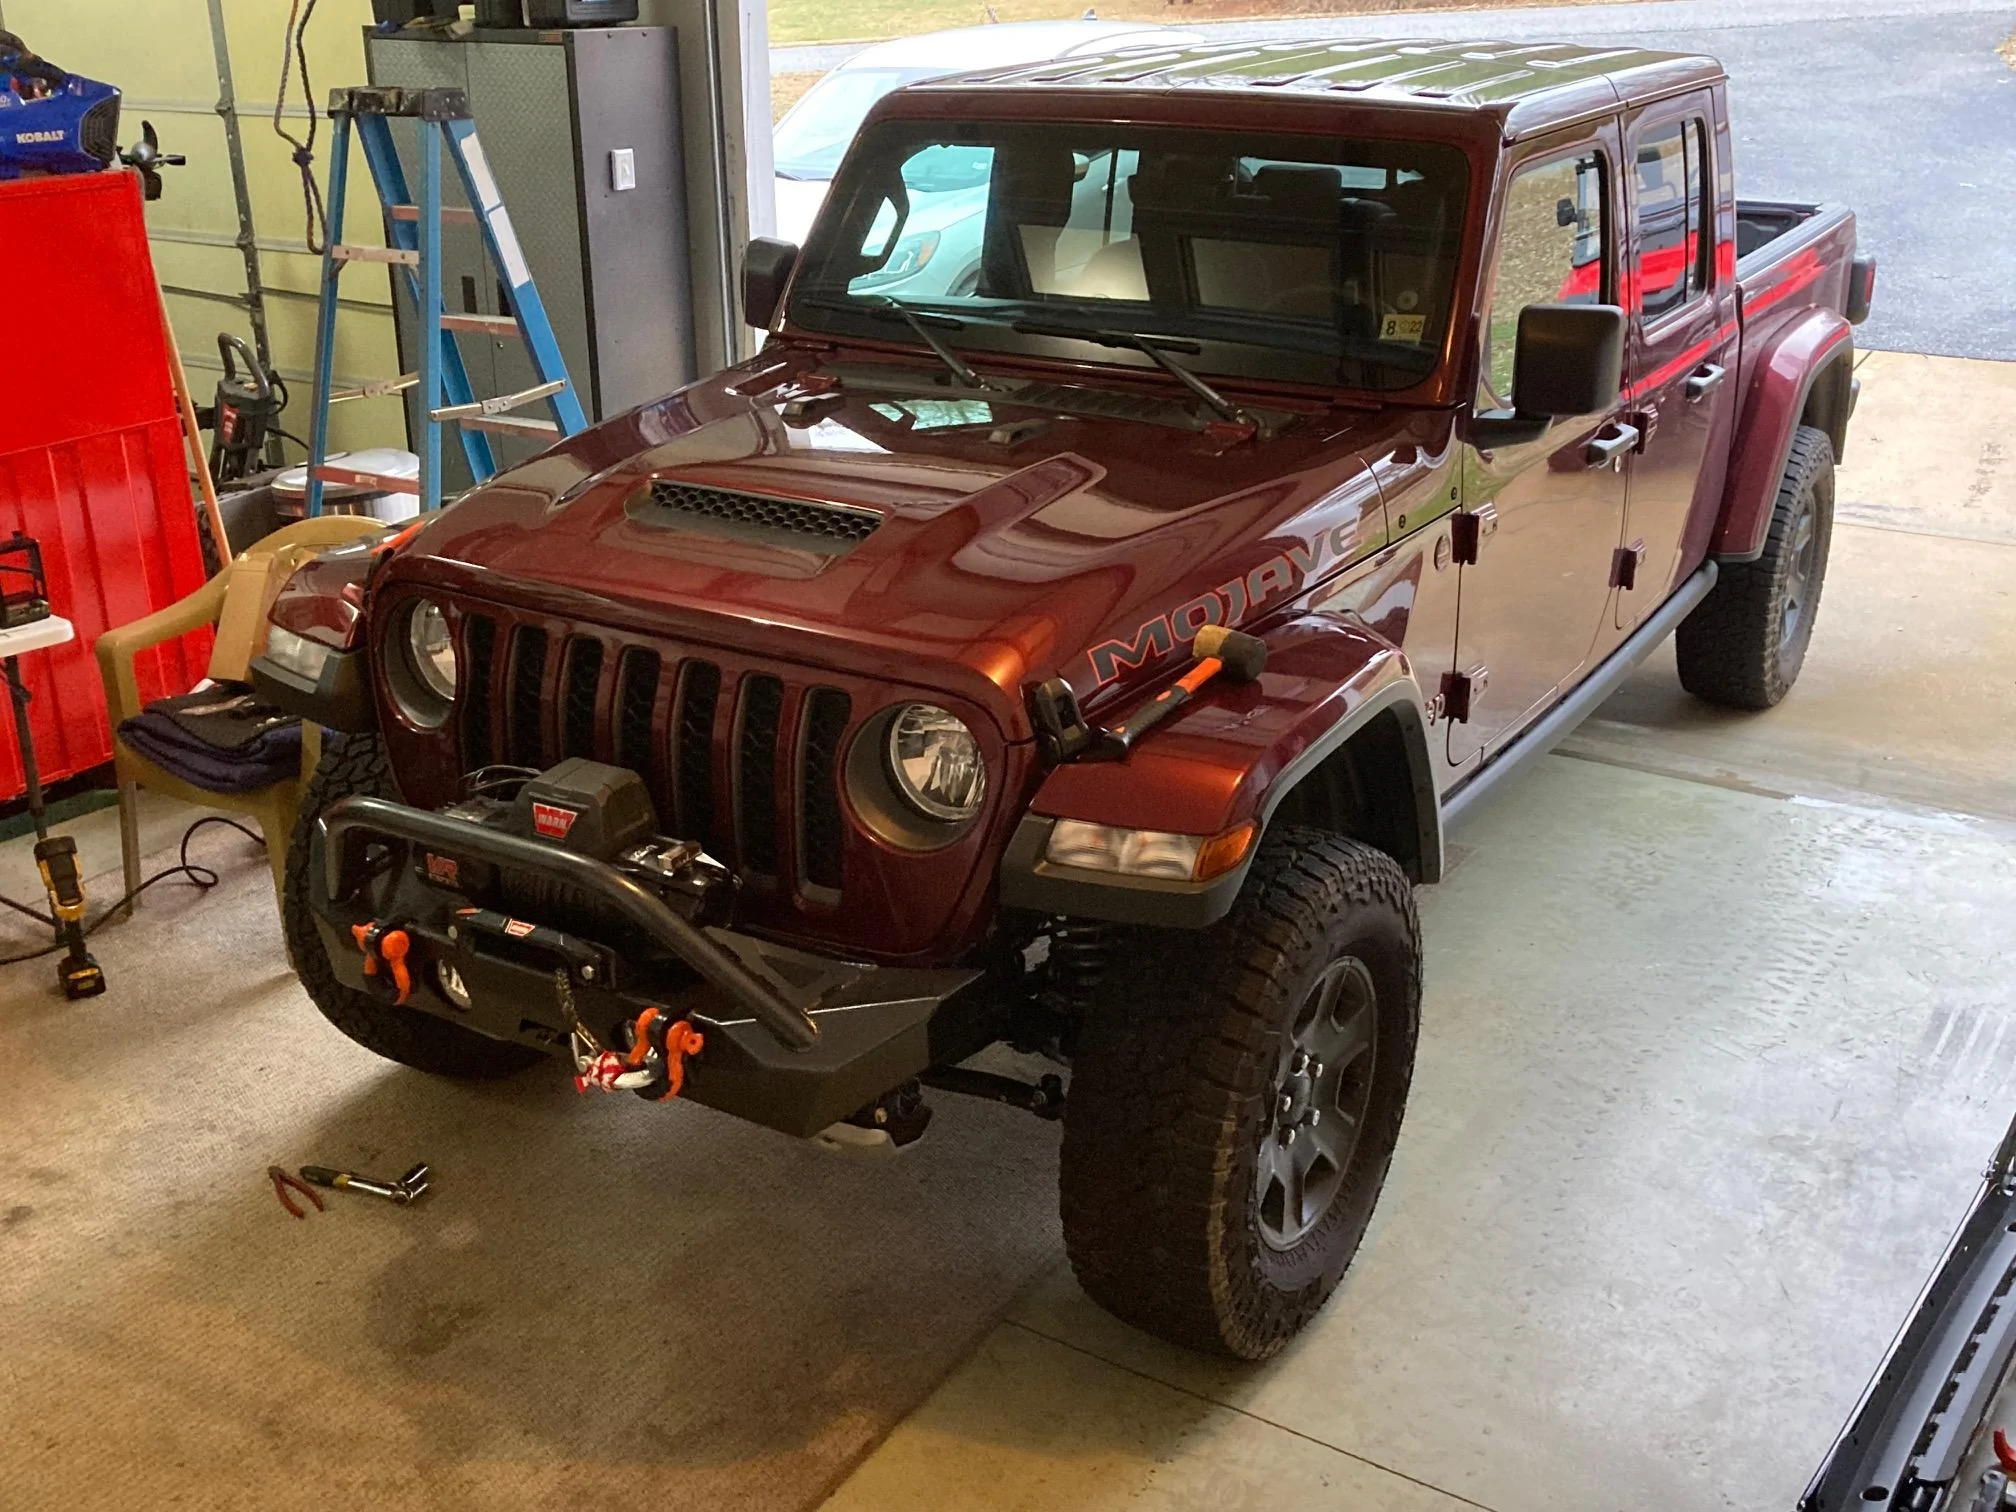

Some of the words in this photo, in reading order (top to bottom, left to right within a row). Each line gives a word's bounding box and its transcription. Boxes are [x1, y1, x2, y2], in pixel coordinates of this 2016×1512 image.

[16, 130, 64, 143] KOBALT
[1386, 320, 1396, 335] 8
[1087, 518, 1362, 686] MOJAVE
[538, 814, 567, 829] WARN
